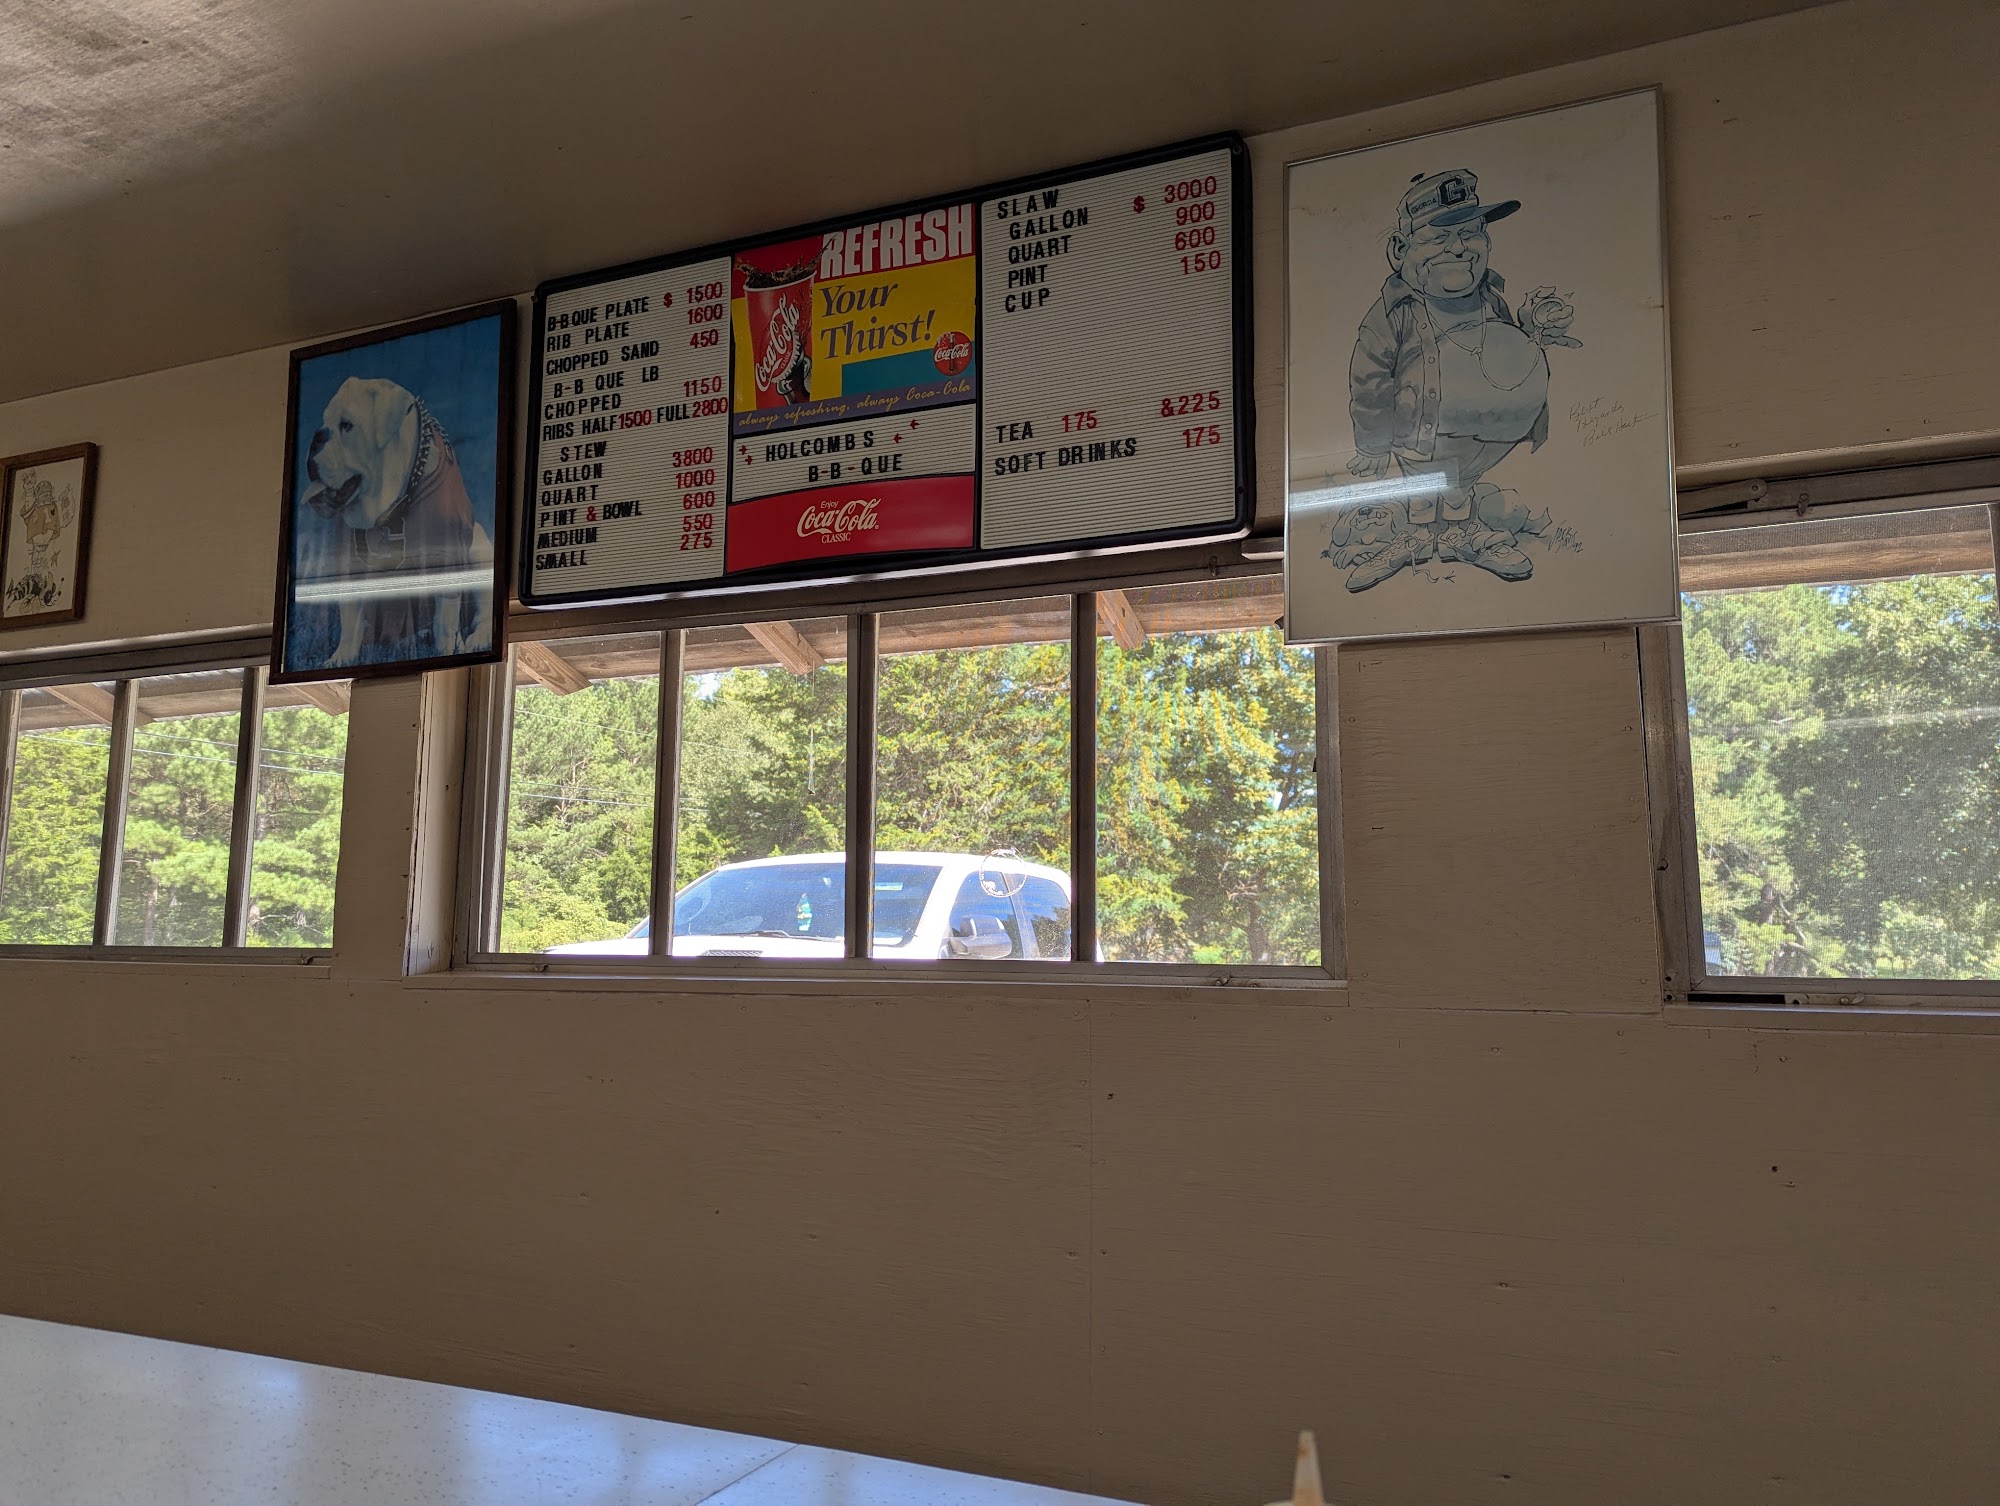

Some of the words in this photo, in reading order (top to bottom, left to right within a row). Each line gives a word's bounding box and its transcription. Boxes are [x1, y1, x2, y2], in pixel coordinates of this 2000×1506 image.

[997, 189, 1059, 219] SLAW
[1009, 207, 1088, 240] GALLON
[1133, 196, 1145, 213] $
[1164, 176, 1216, 204] 3000
[1411, 198, 1437, 213] GEORGIA
[820, 203, 972, 279] REFRESH
[1008, 235, 1071, 265] QUART
[1176, 201, 1215, 226] 900
[1008, 264, 1047, 289] PINT
[1175, 226, 1215, 251] 600
[1005, 288, 1051, 313] CUP
[1180, 250, 1221, 275] 150
[605, 297, 649, 319] PLATE
[663, 292, 672, 308] $
[687, 282, 722, 304] 1500
[819, 283, 898, 318] Your
[547, 334, 570, 352] RIB
[585, 321, 629, 344] PLATE
[687, 304, 723, 324] 1600
[820, 310, 935, 360] Thirst!
[546, 350, 608, 375] CHOPPED
[621, 341, 659, 361] SAND
[690, 329, 718, 348] 450
[595, 371, 624, 390] QUE
[642, 366, 659, 382] LB
[544, 393, 621, 420] CHOPPED
[684, 376, 721, 397] 1150
[739, 413, 779, 429] always
[785, 402, 850, 420] refreshing,
[857, 394, 900, 411] always
[906, 379, 970, 401] Coca-Cola
[1570, 396, 1606, 421] Best
[543, 422, 574, 441] RIBS
[995, 421, 1033, 444] TEA
[1062, 410, 1097, 432] 175
[543, 463, 602, 485] GALLON
[673, 447, 713, 467] 3800
[560, 441, 607, 462] STEW
[994, 452, 1045, 476] SOFT
[1058, 437, 1137, 466] DRINKS
[1182, 425, 1220, 448] 175
[541, 485, 598, 506] QUART
[676, 469, 714, 489] 1000
[821, 500, 839, 509] Enjoy
[540, 509, 576, 527] PINT
[586, 506, 597, 521] &
[603, 500, 642, 520] BOWL
[683, 491, 715, 509] 600
[537, 527, 599, 549] MEDIUM
[682, 514, 713, 532] 550
[821, 532, 851, 544] CLASSIC
[536, 550, 588, 570] SMALL
[680, 532, 713, 550] 275
